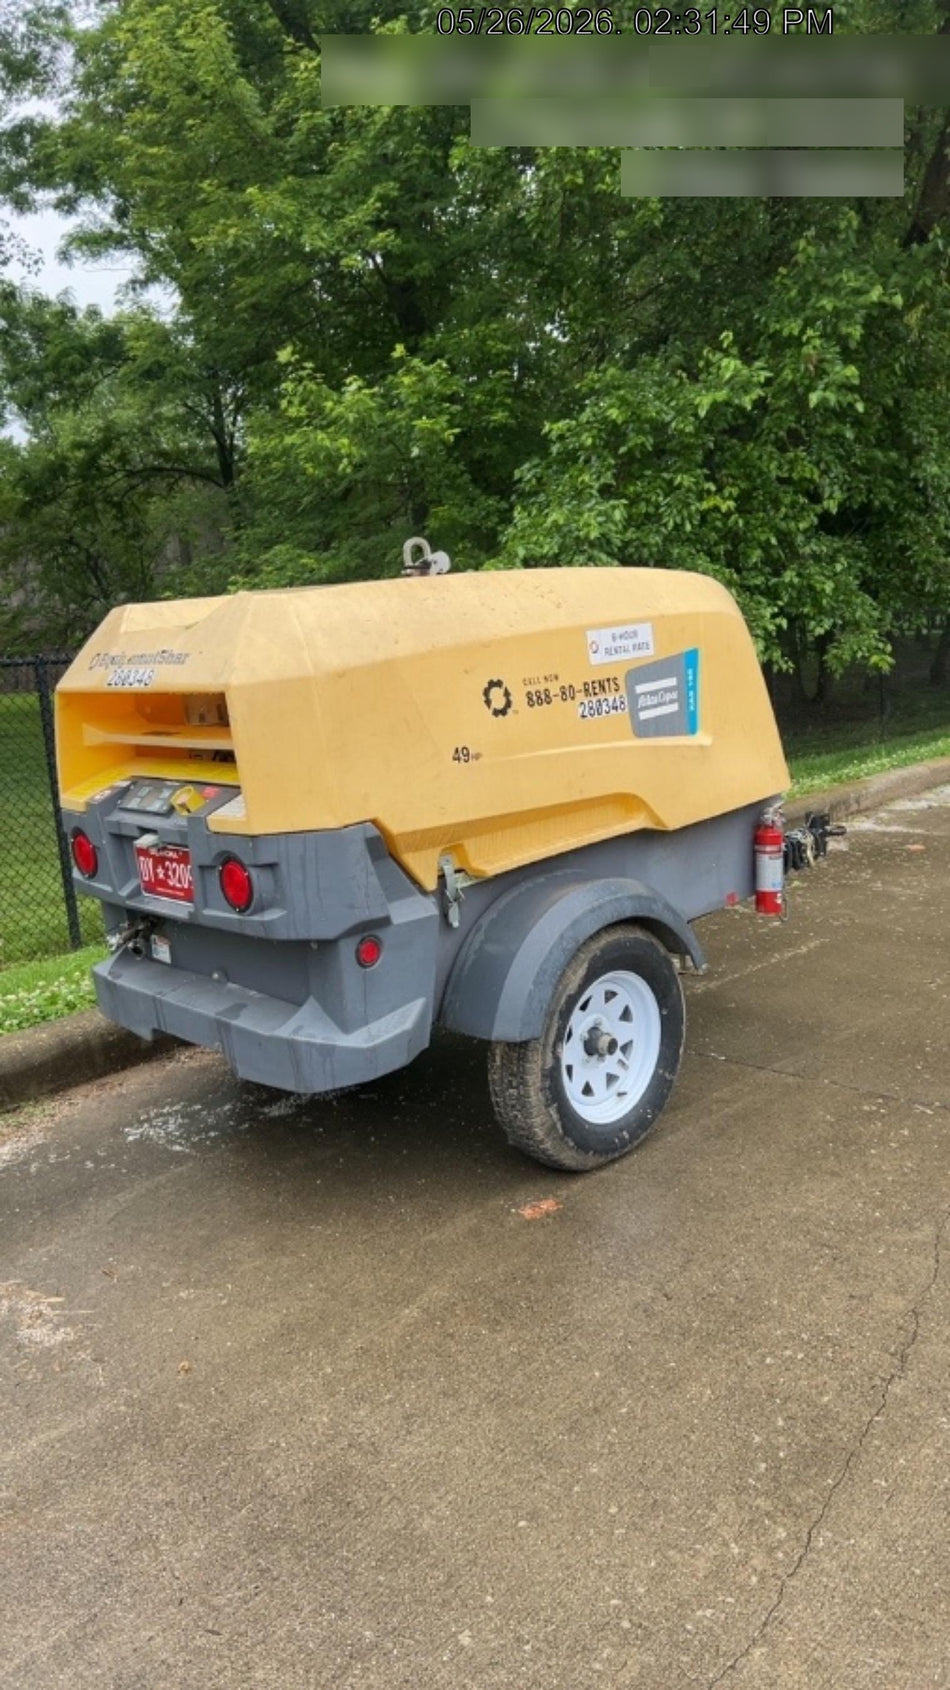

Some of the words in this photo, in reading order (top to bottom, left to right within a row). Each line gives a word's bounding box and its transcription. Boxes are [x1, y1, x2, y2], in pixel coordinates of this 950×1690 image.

[525, 676, 621, 708] 888-80-RENTS
[578, 695, 626, 718] 280348
[452, 746, 470, 764] 49
